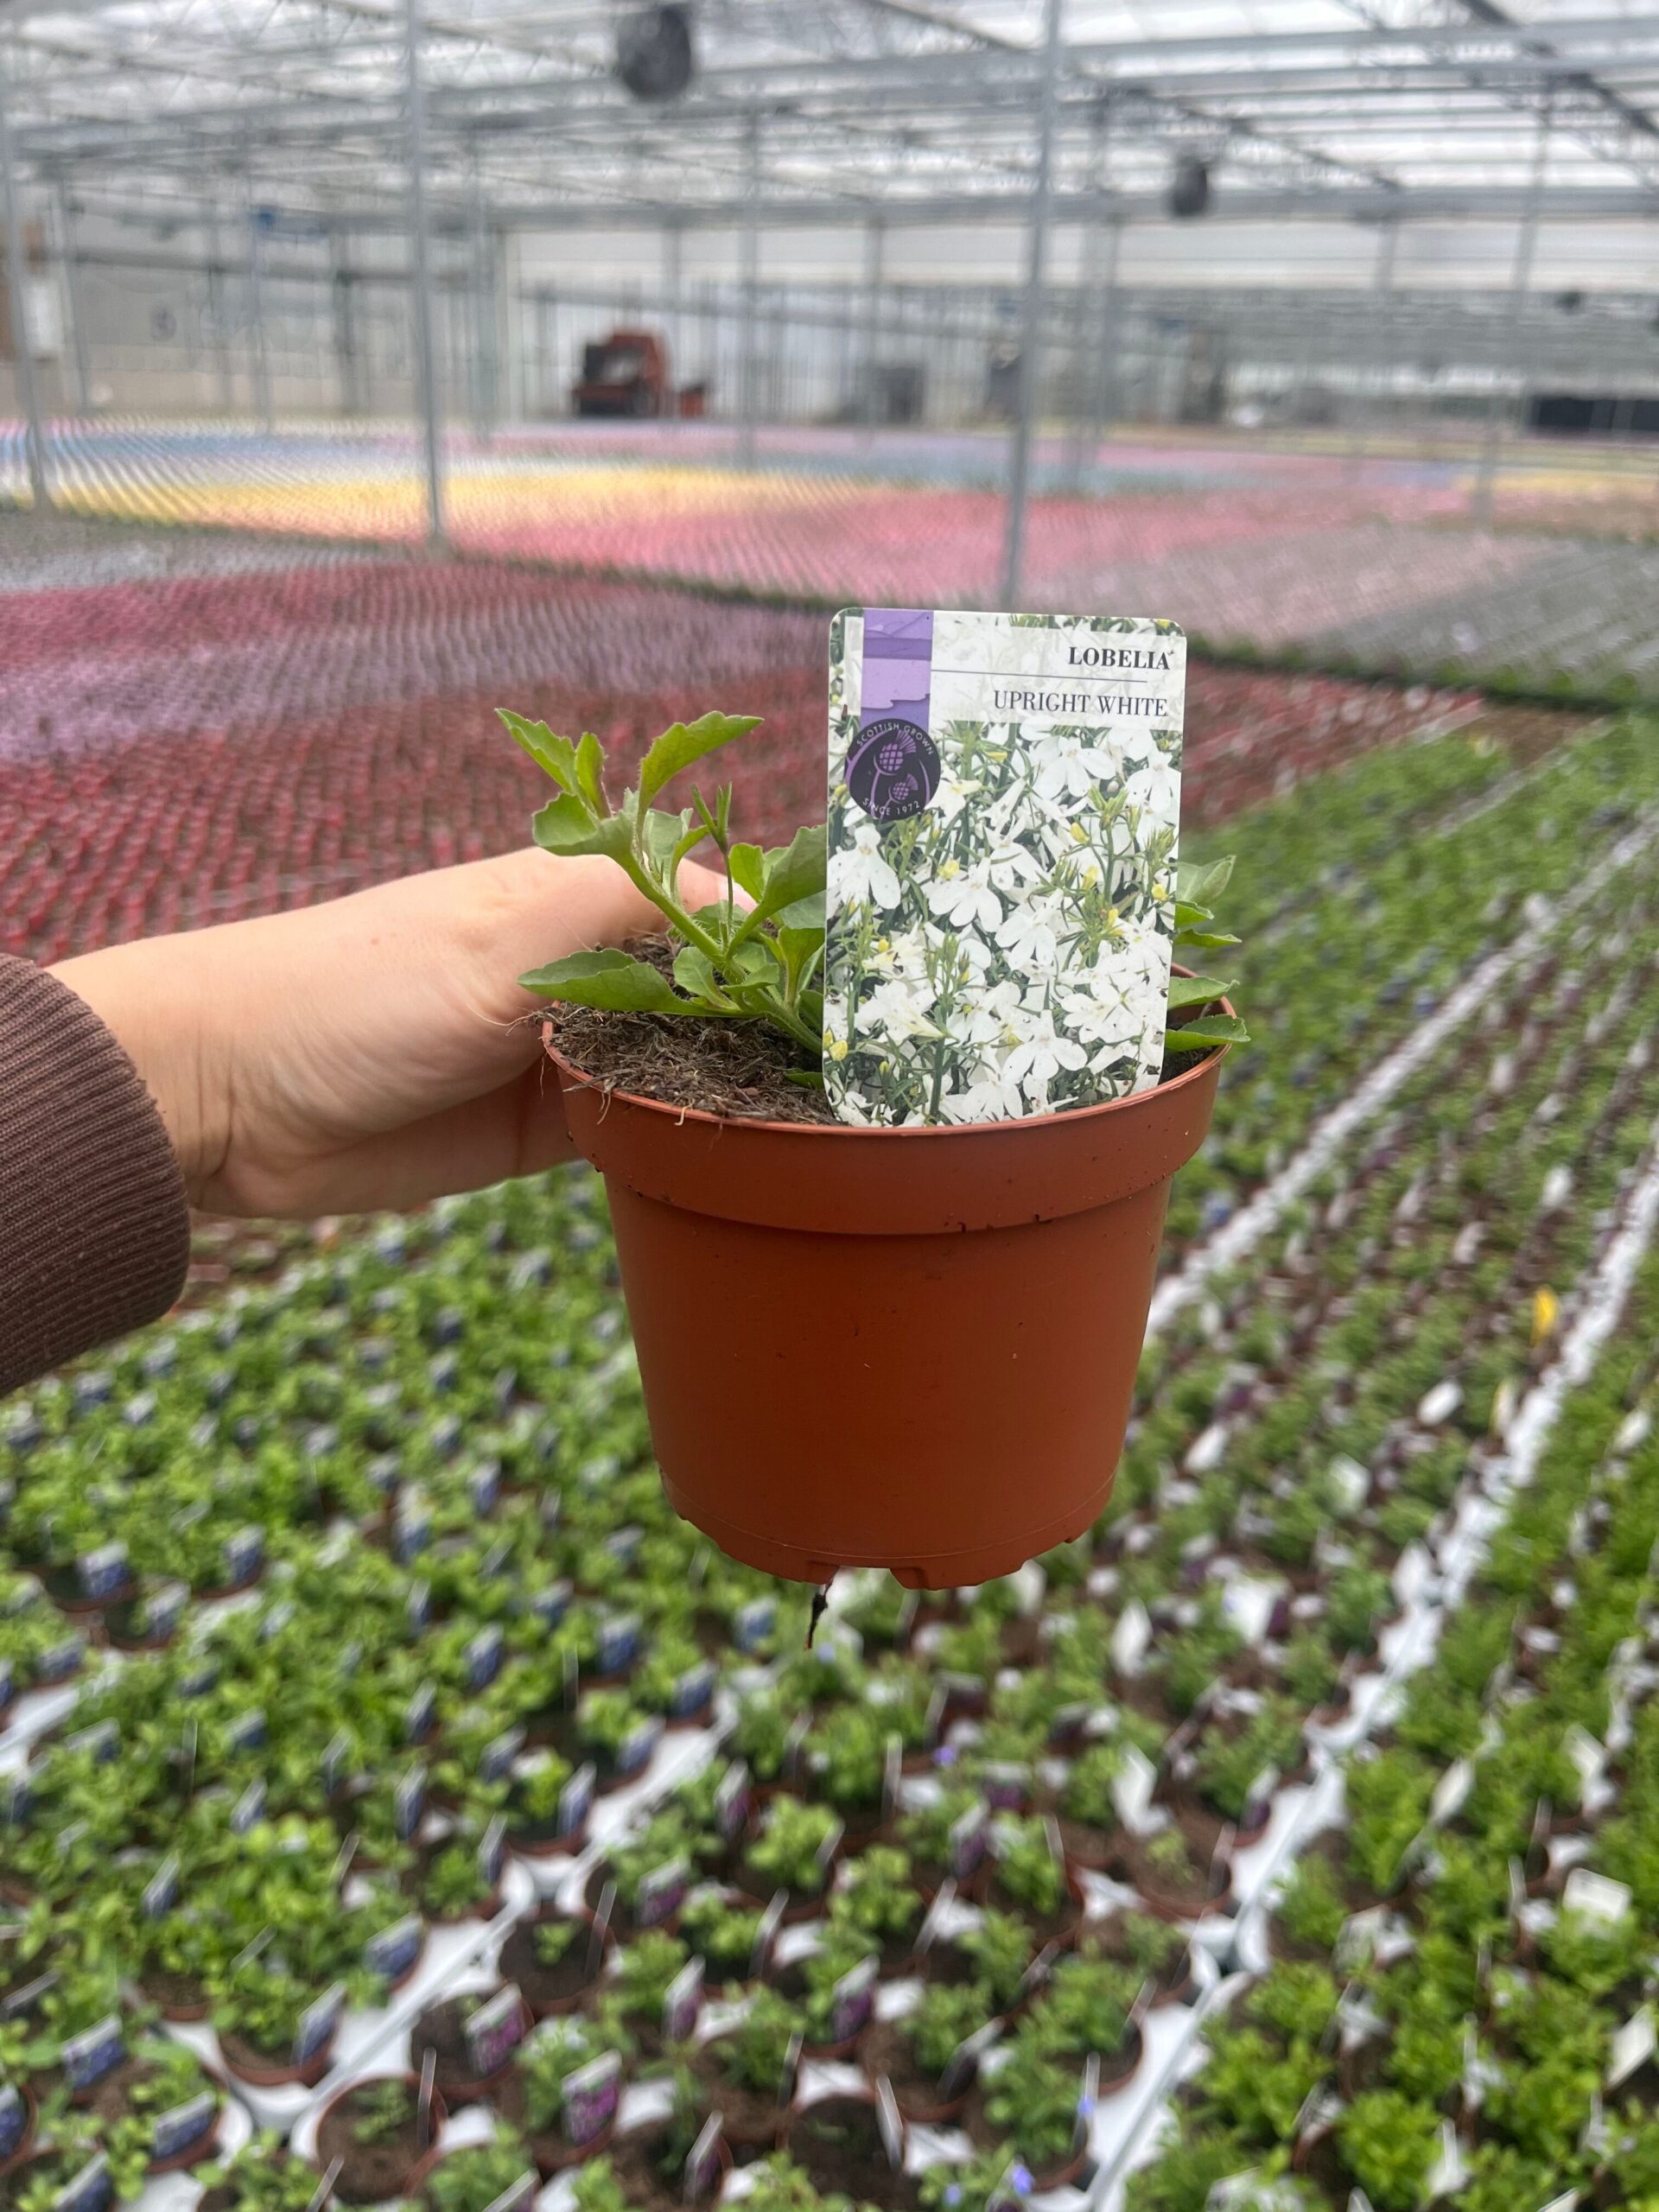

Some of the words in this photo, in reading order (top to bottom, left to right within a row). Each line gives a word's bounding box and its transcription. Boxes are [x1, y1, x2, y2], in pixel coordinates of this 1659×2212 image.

[1069, 646, 1171, 671] LOBELIA
[994, 690, 1091, 714] UPRIGHT
[1098, 695, 1168, 717] WHITE
[857, 722, 899, 747] SCOTTISH
[904, 725, 934, 755] GROWN
[862, 798, 891, 816] SINCE
[897, 800, 920, 815] 1972
